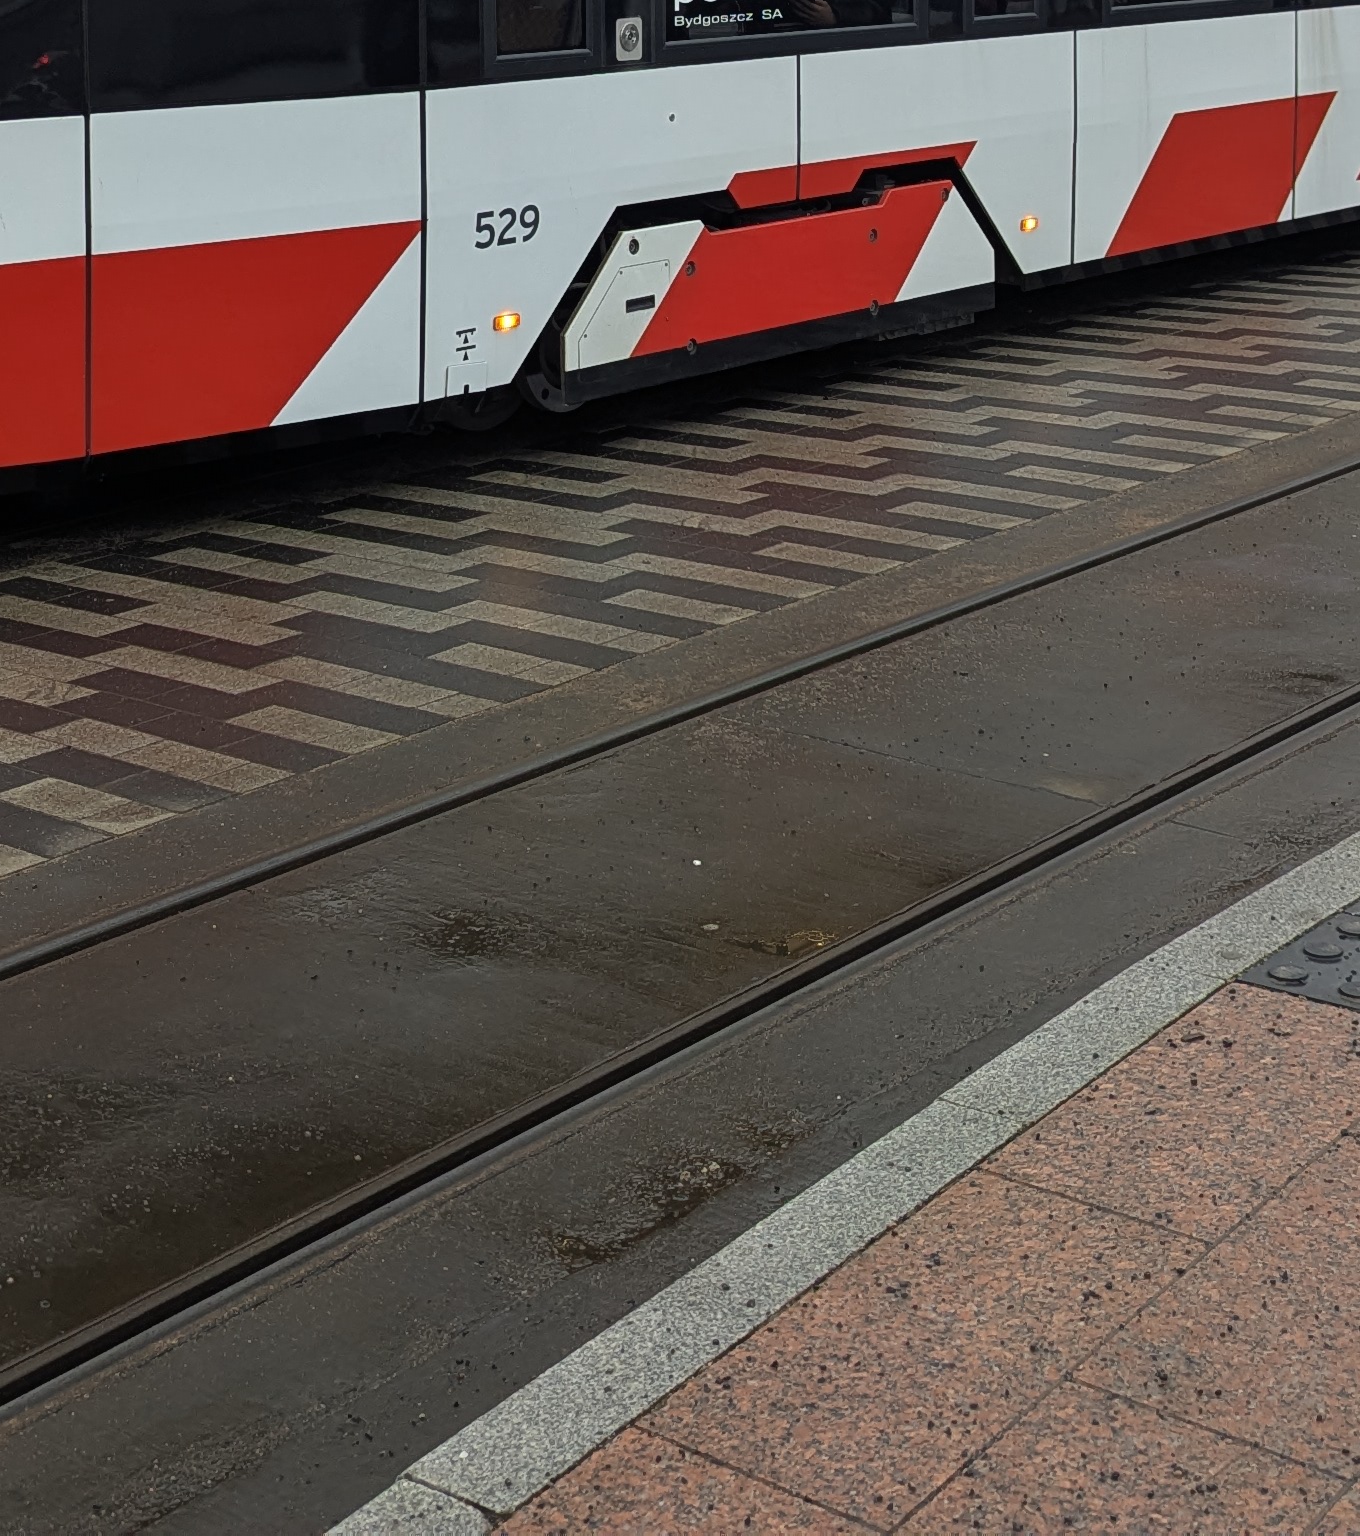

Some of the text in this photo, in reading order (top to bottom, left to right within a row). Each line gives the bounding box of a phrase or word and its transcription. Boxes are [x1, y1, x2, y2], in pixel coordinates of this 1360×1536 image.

[674, 8, 784, 29] Bydgoszcz SA
[473, 203, 540, 250] 529
